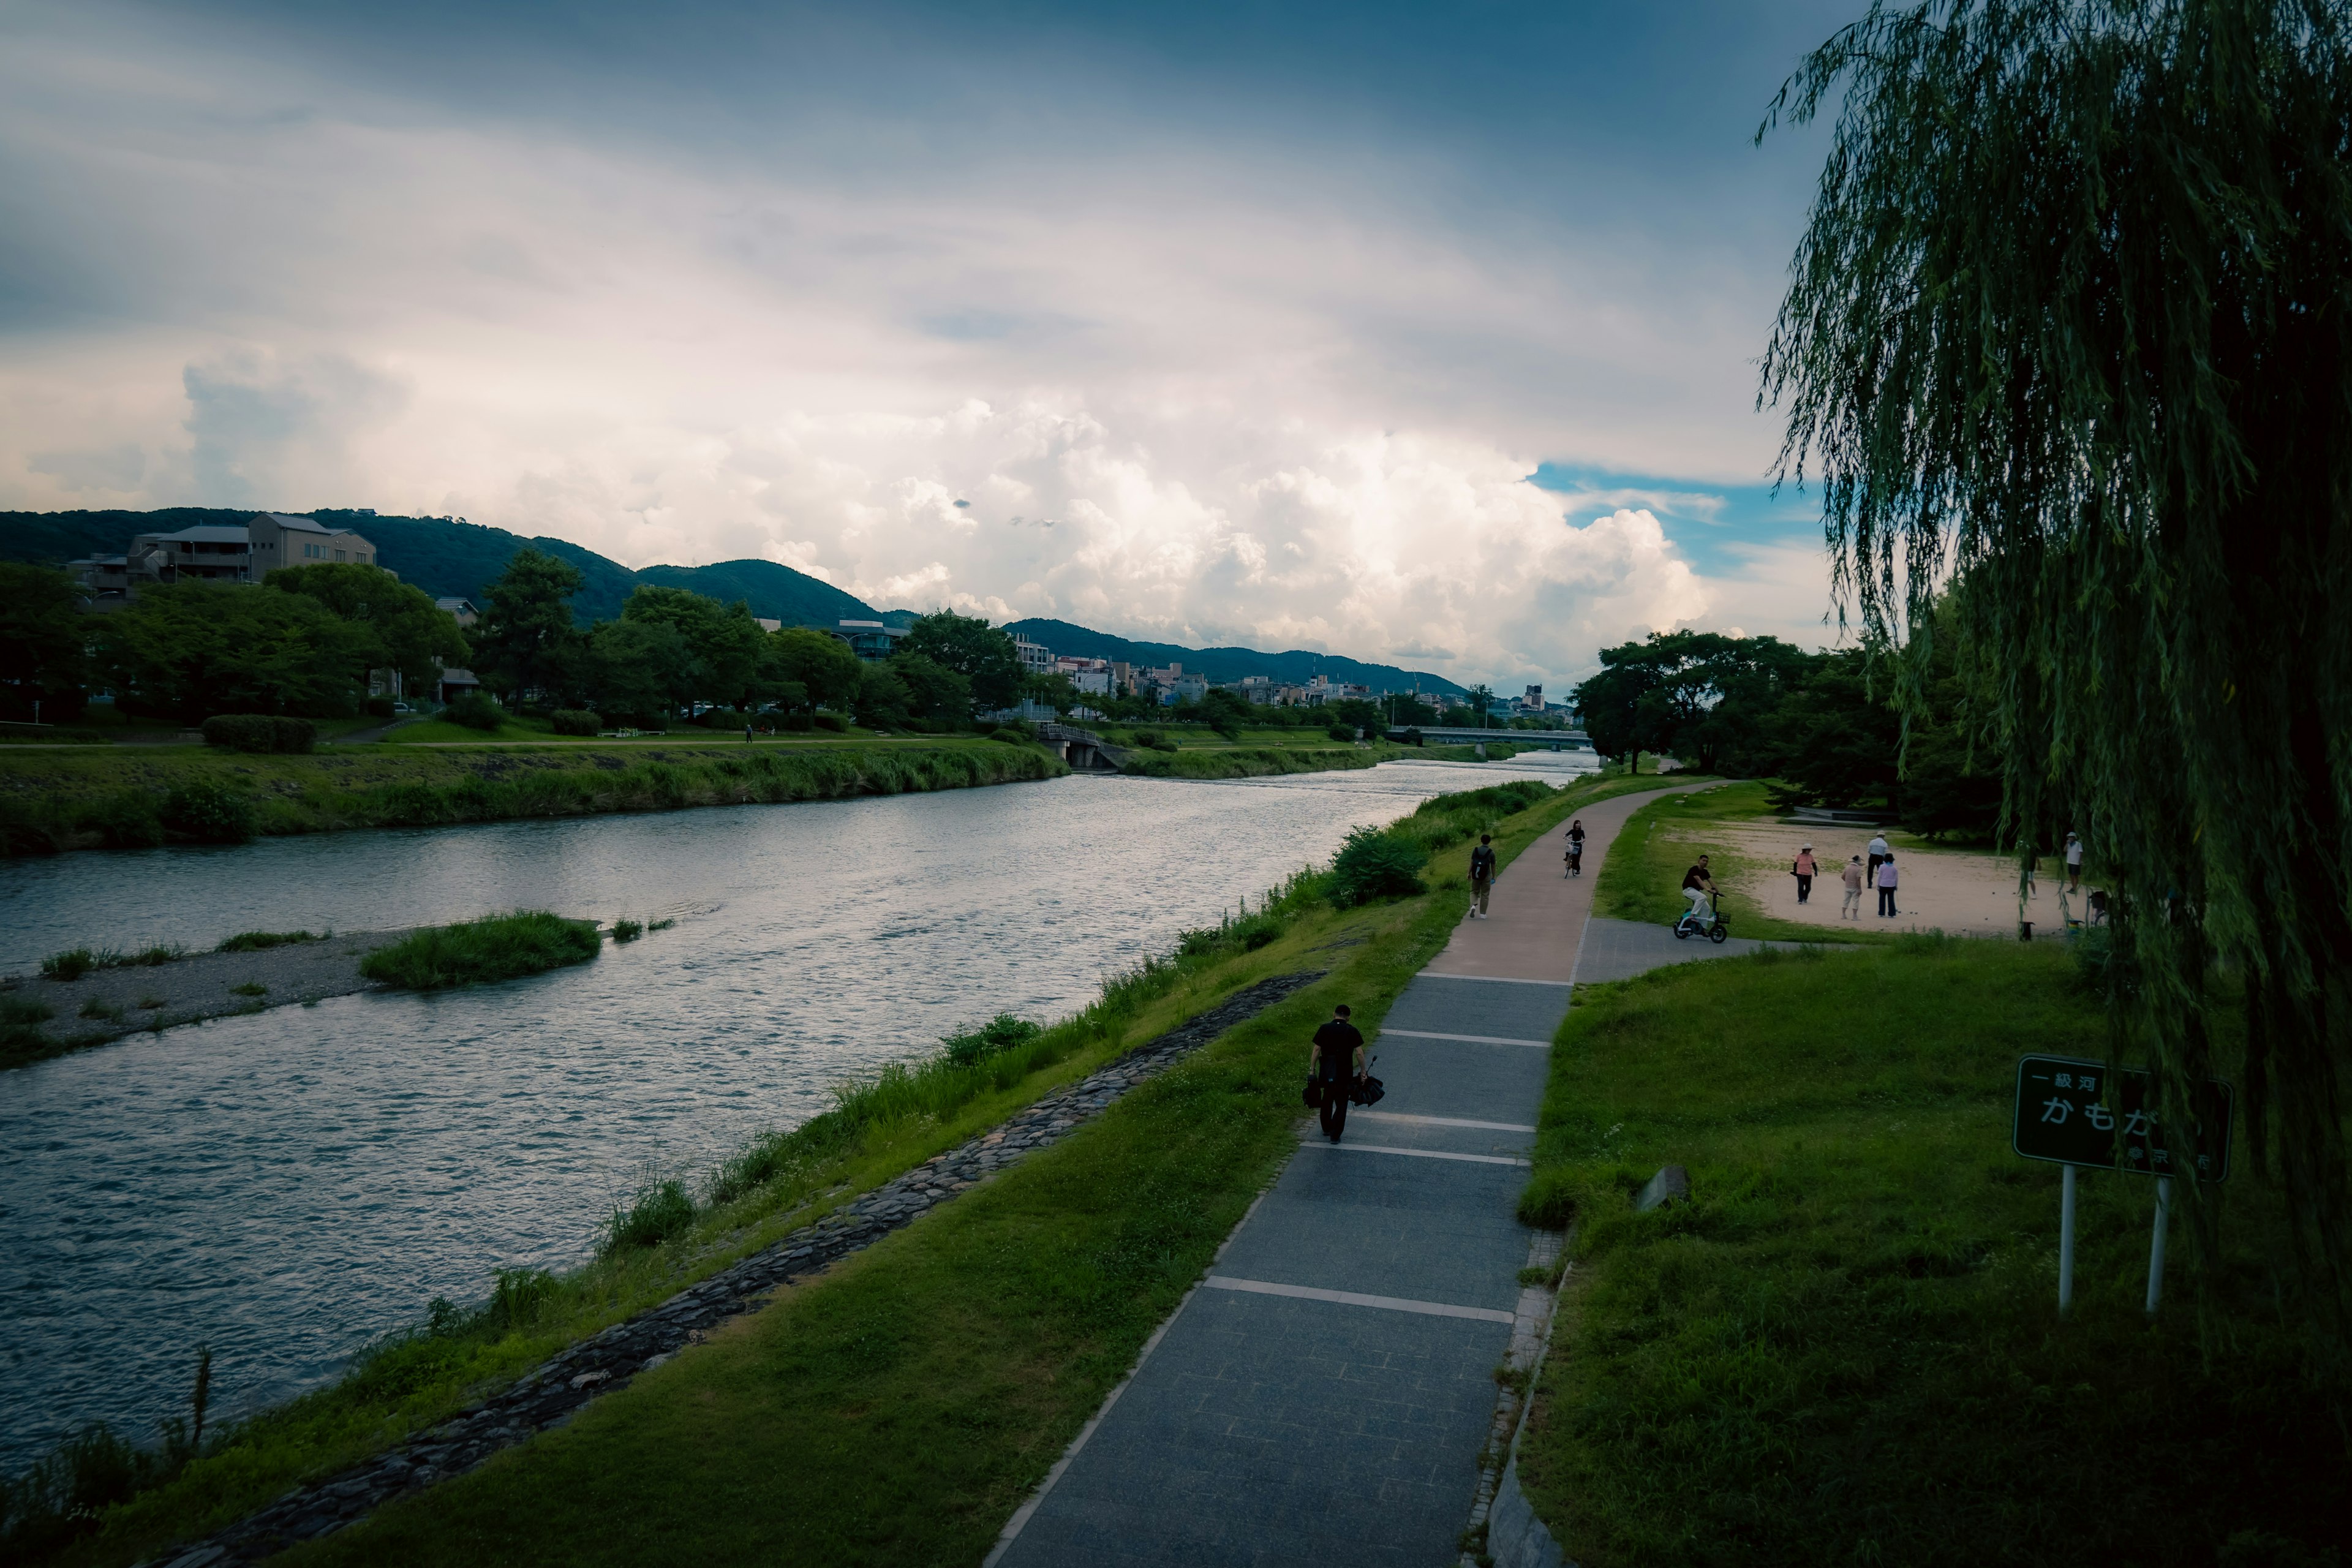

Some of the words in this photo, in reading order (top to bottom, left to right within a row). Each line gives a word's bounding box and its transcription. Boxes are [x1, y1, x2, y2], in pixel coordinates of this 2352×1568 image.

[2032, 1072, 2098, 1092] 一級河
[2040, 1096, 2203, 1137] かもが
